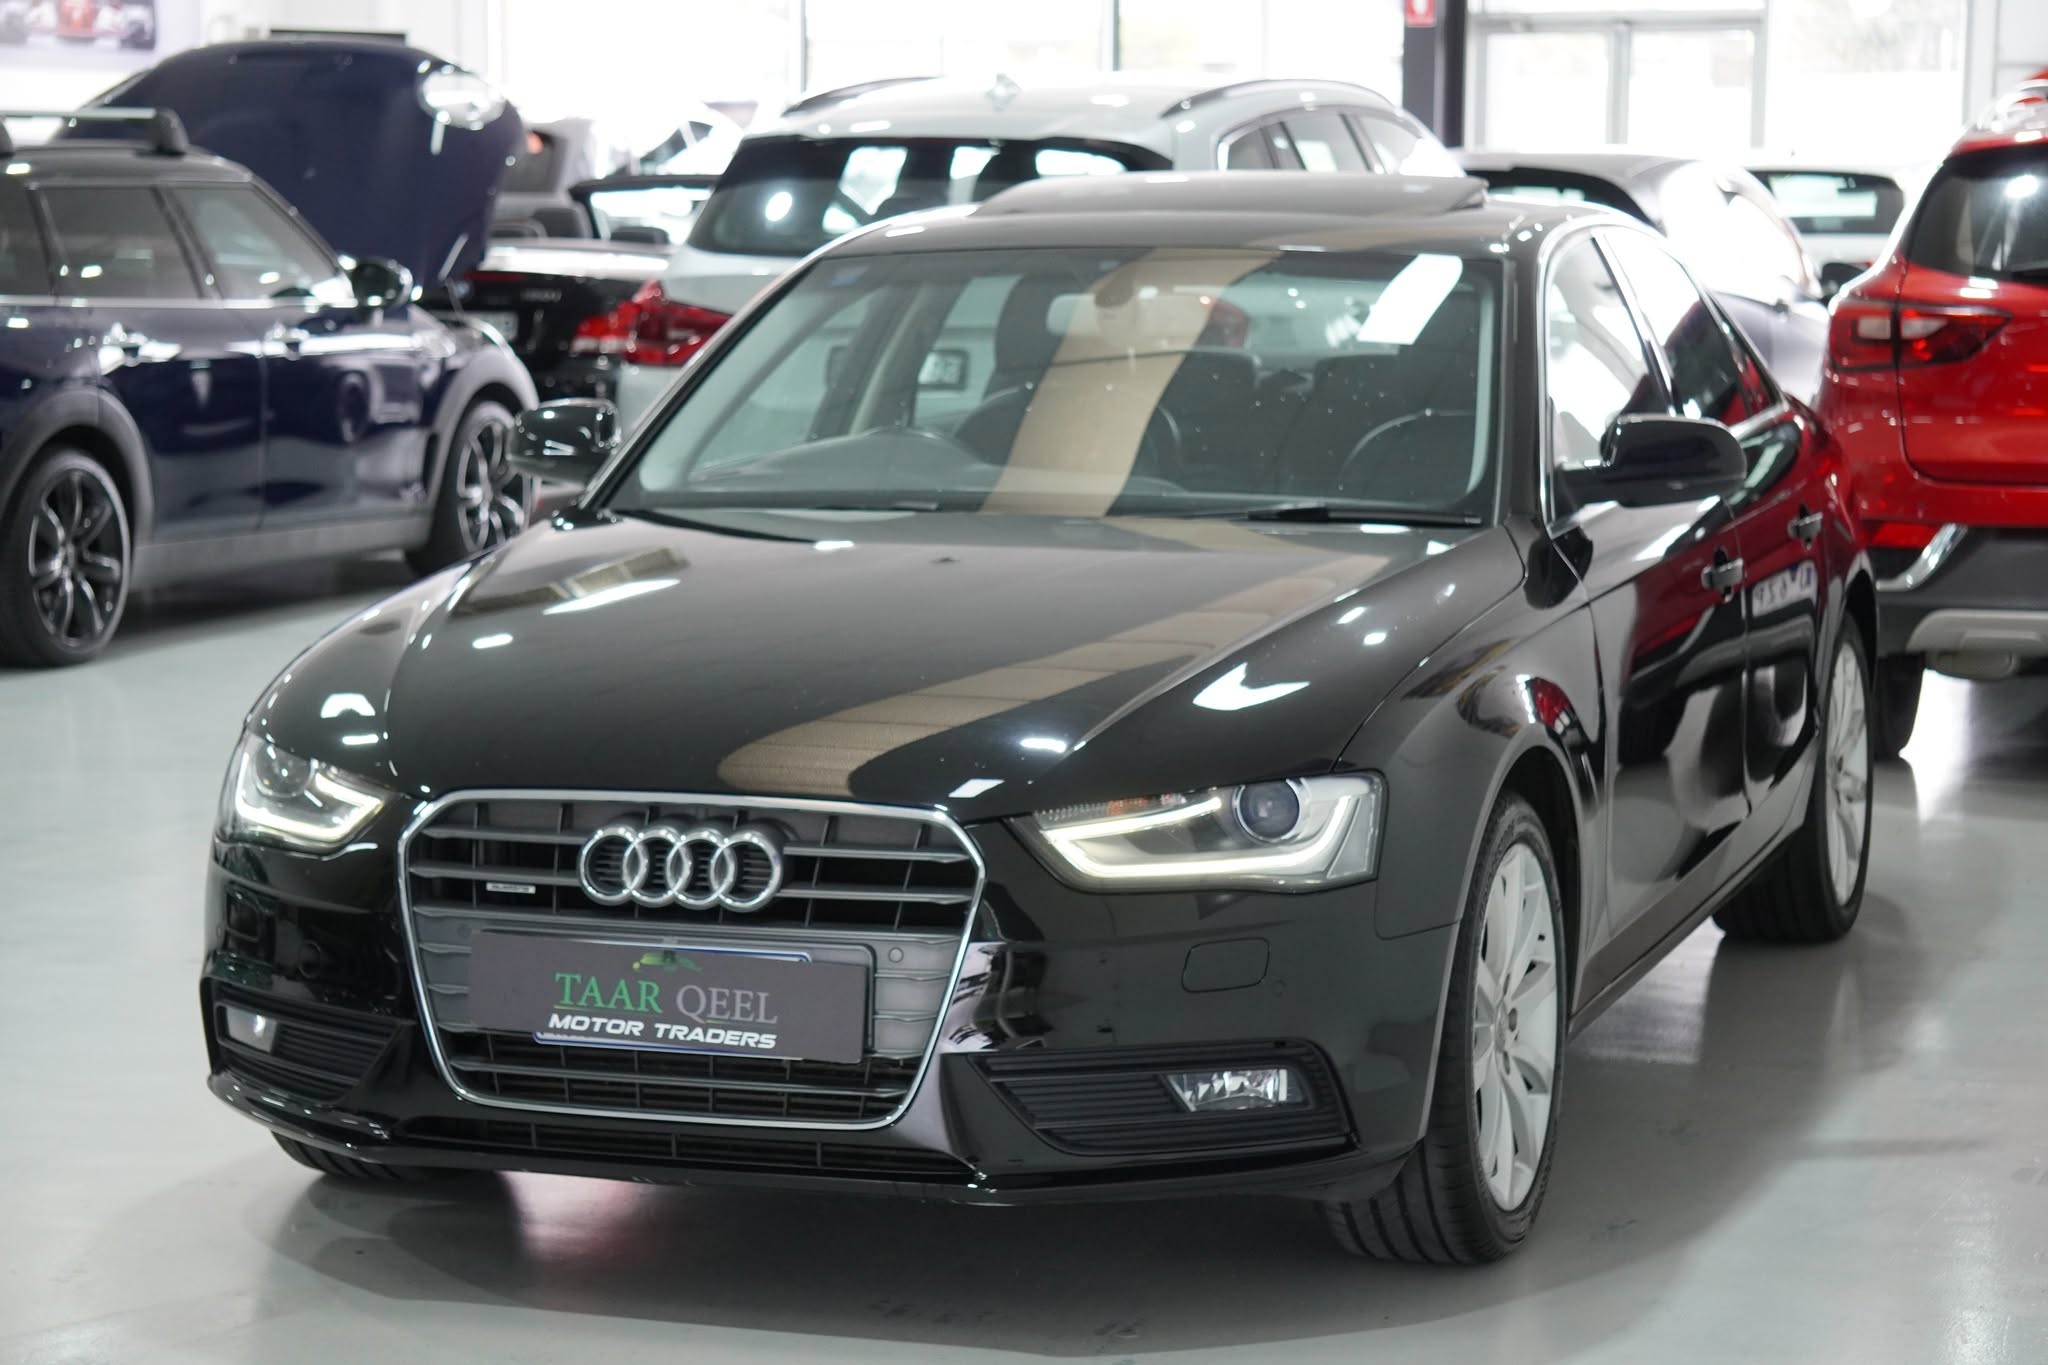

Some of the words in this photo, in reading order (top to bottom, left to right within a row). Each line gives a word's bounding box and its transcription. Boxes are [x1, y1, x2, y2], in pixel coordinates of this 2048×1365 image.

[554, 972, 662, 1013] TAAR
[677, 985, 778, 1024] QEEL
[549, 1014, 644, 1036] MOTOR
[655, 1023, 777, 1049] TRADERS
